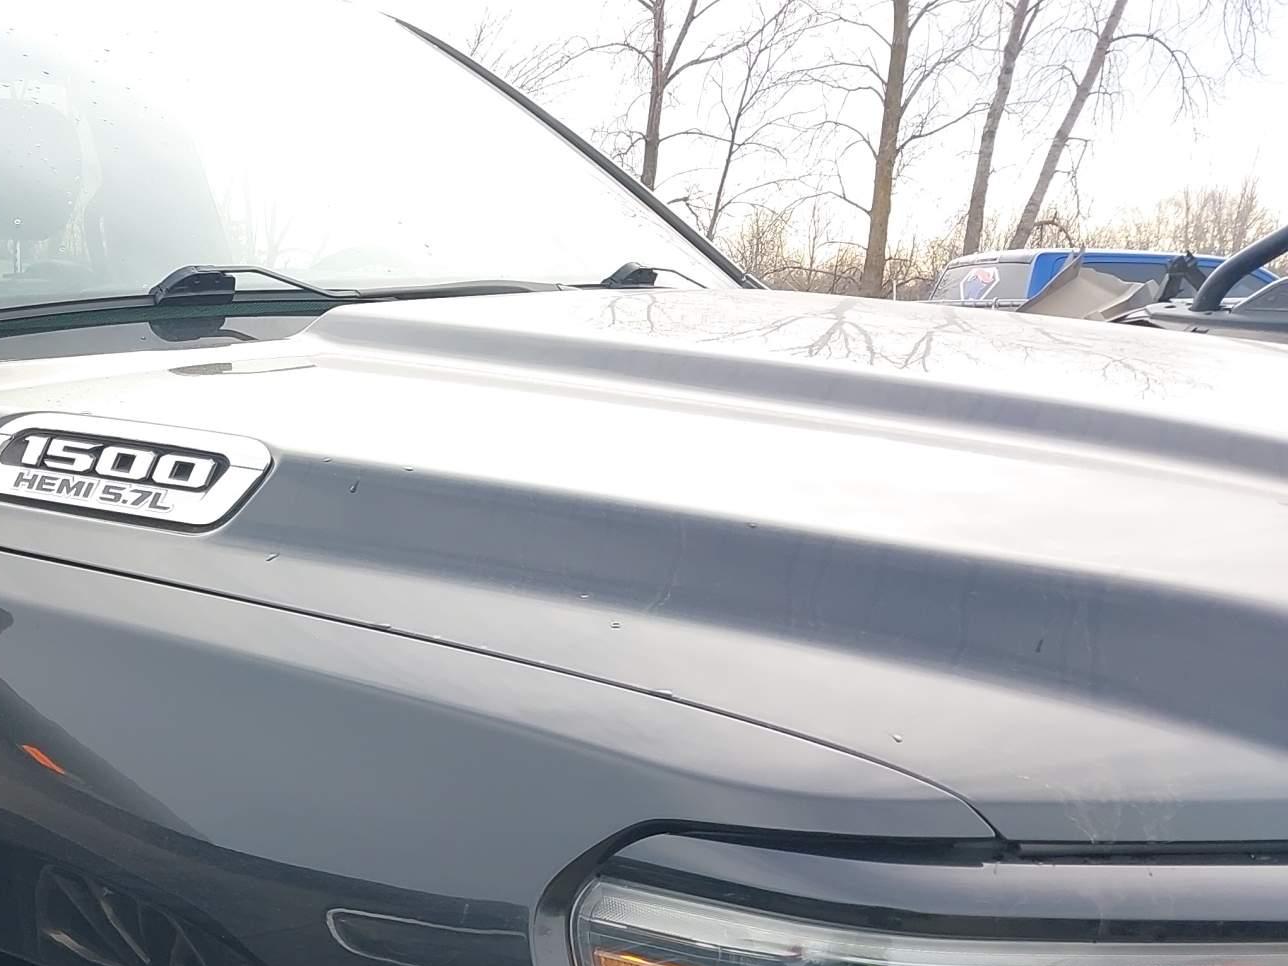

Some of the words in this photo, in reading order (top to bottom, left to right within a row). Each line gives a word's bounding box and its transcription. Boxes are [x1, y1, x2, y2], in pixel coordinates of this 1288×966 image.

[22, 434, 216, 489] 1500
[13, 471, 94, 499] HEMI
[99, 485, 173, 511] 5.7L
